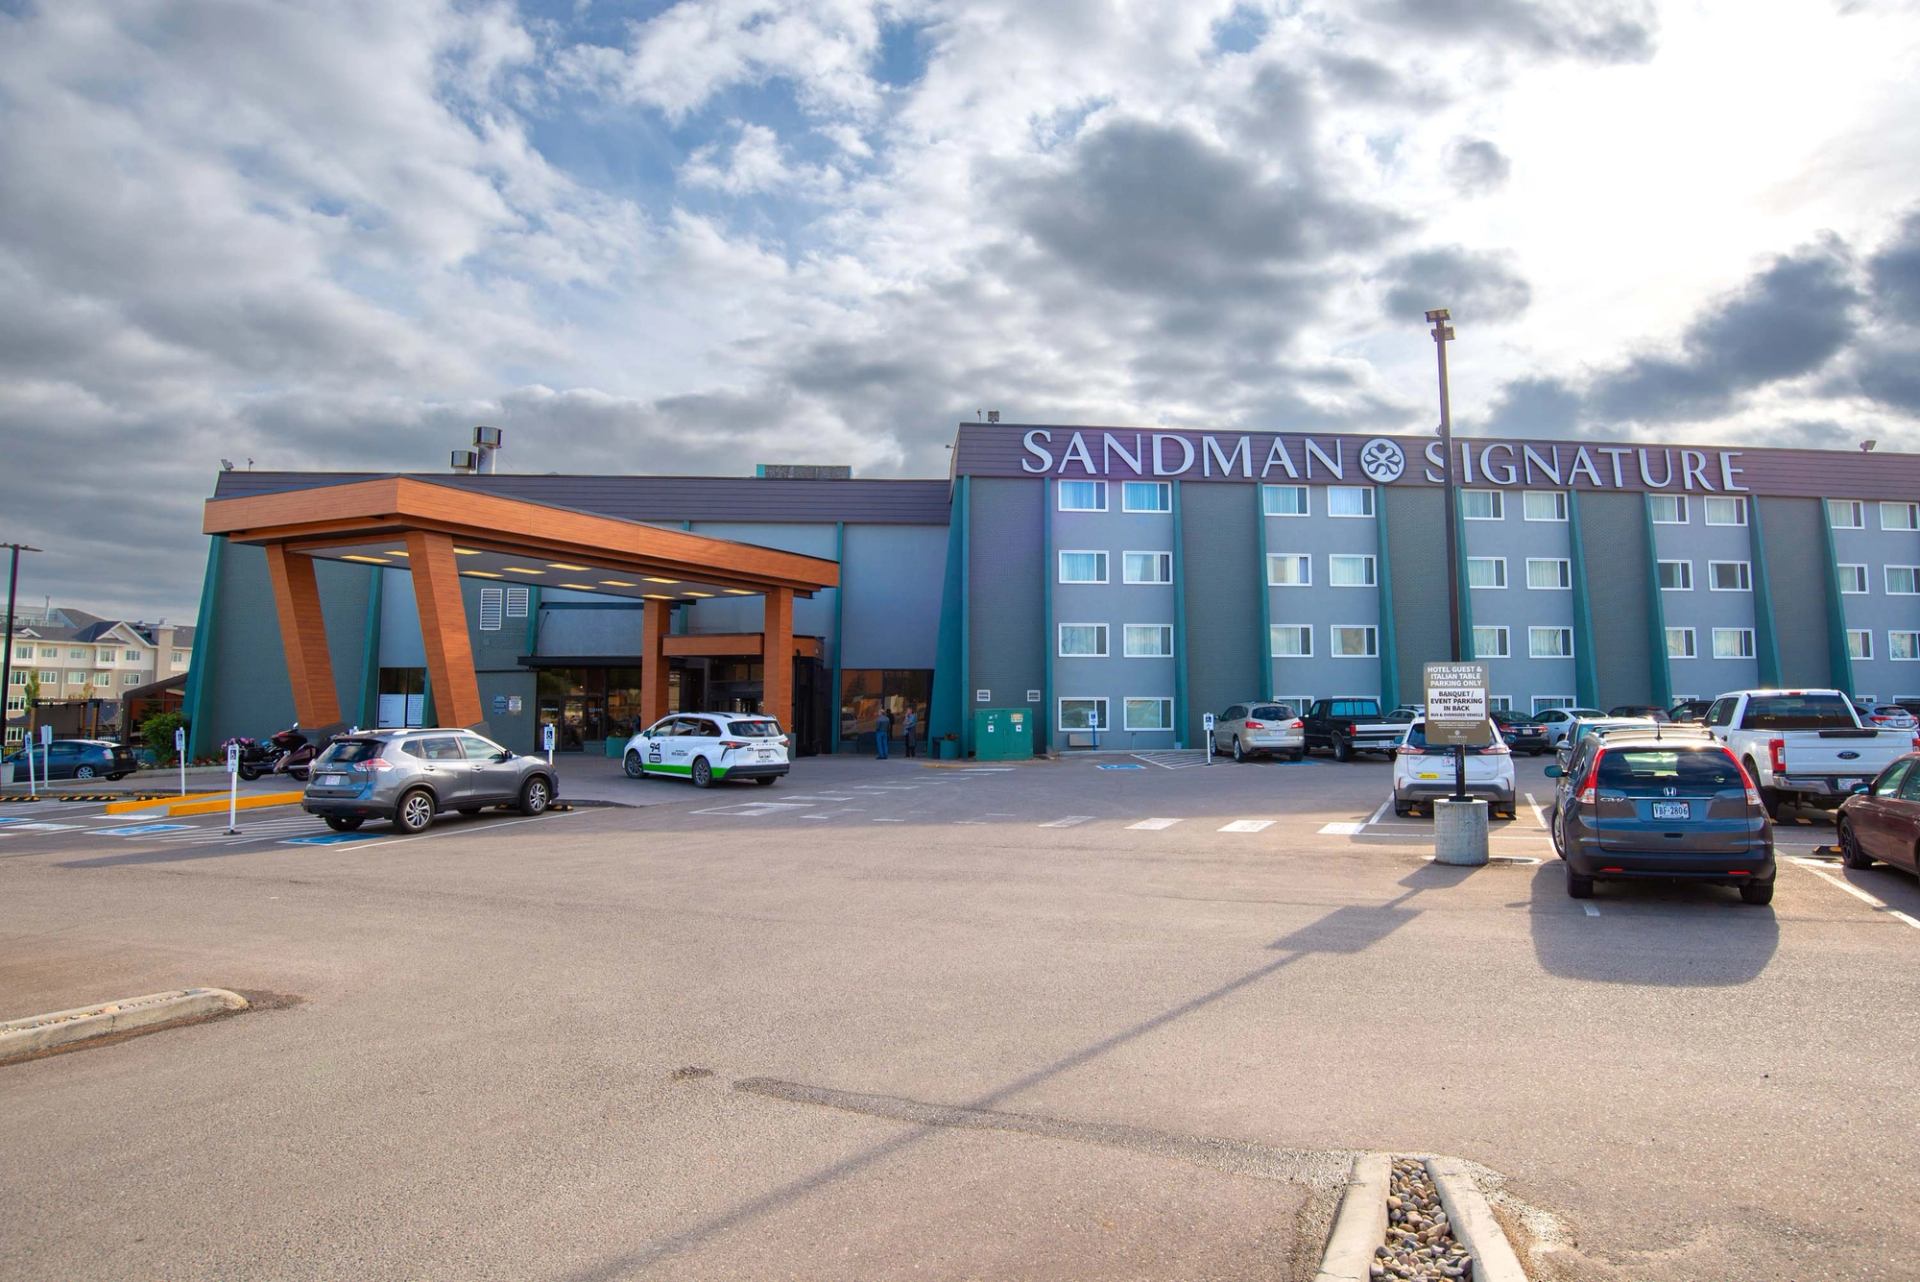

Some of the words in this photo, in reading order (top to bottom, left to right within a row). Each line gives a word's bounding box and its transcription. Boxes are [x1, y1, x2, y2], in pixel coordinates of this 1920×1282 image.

[1021, 429, 1343, 480] SANDMAN
[1424, 441, 1750, 492] SIGNATURE
[649, 742, 661, 753] 94
